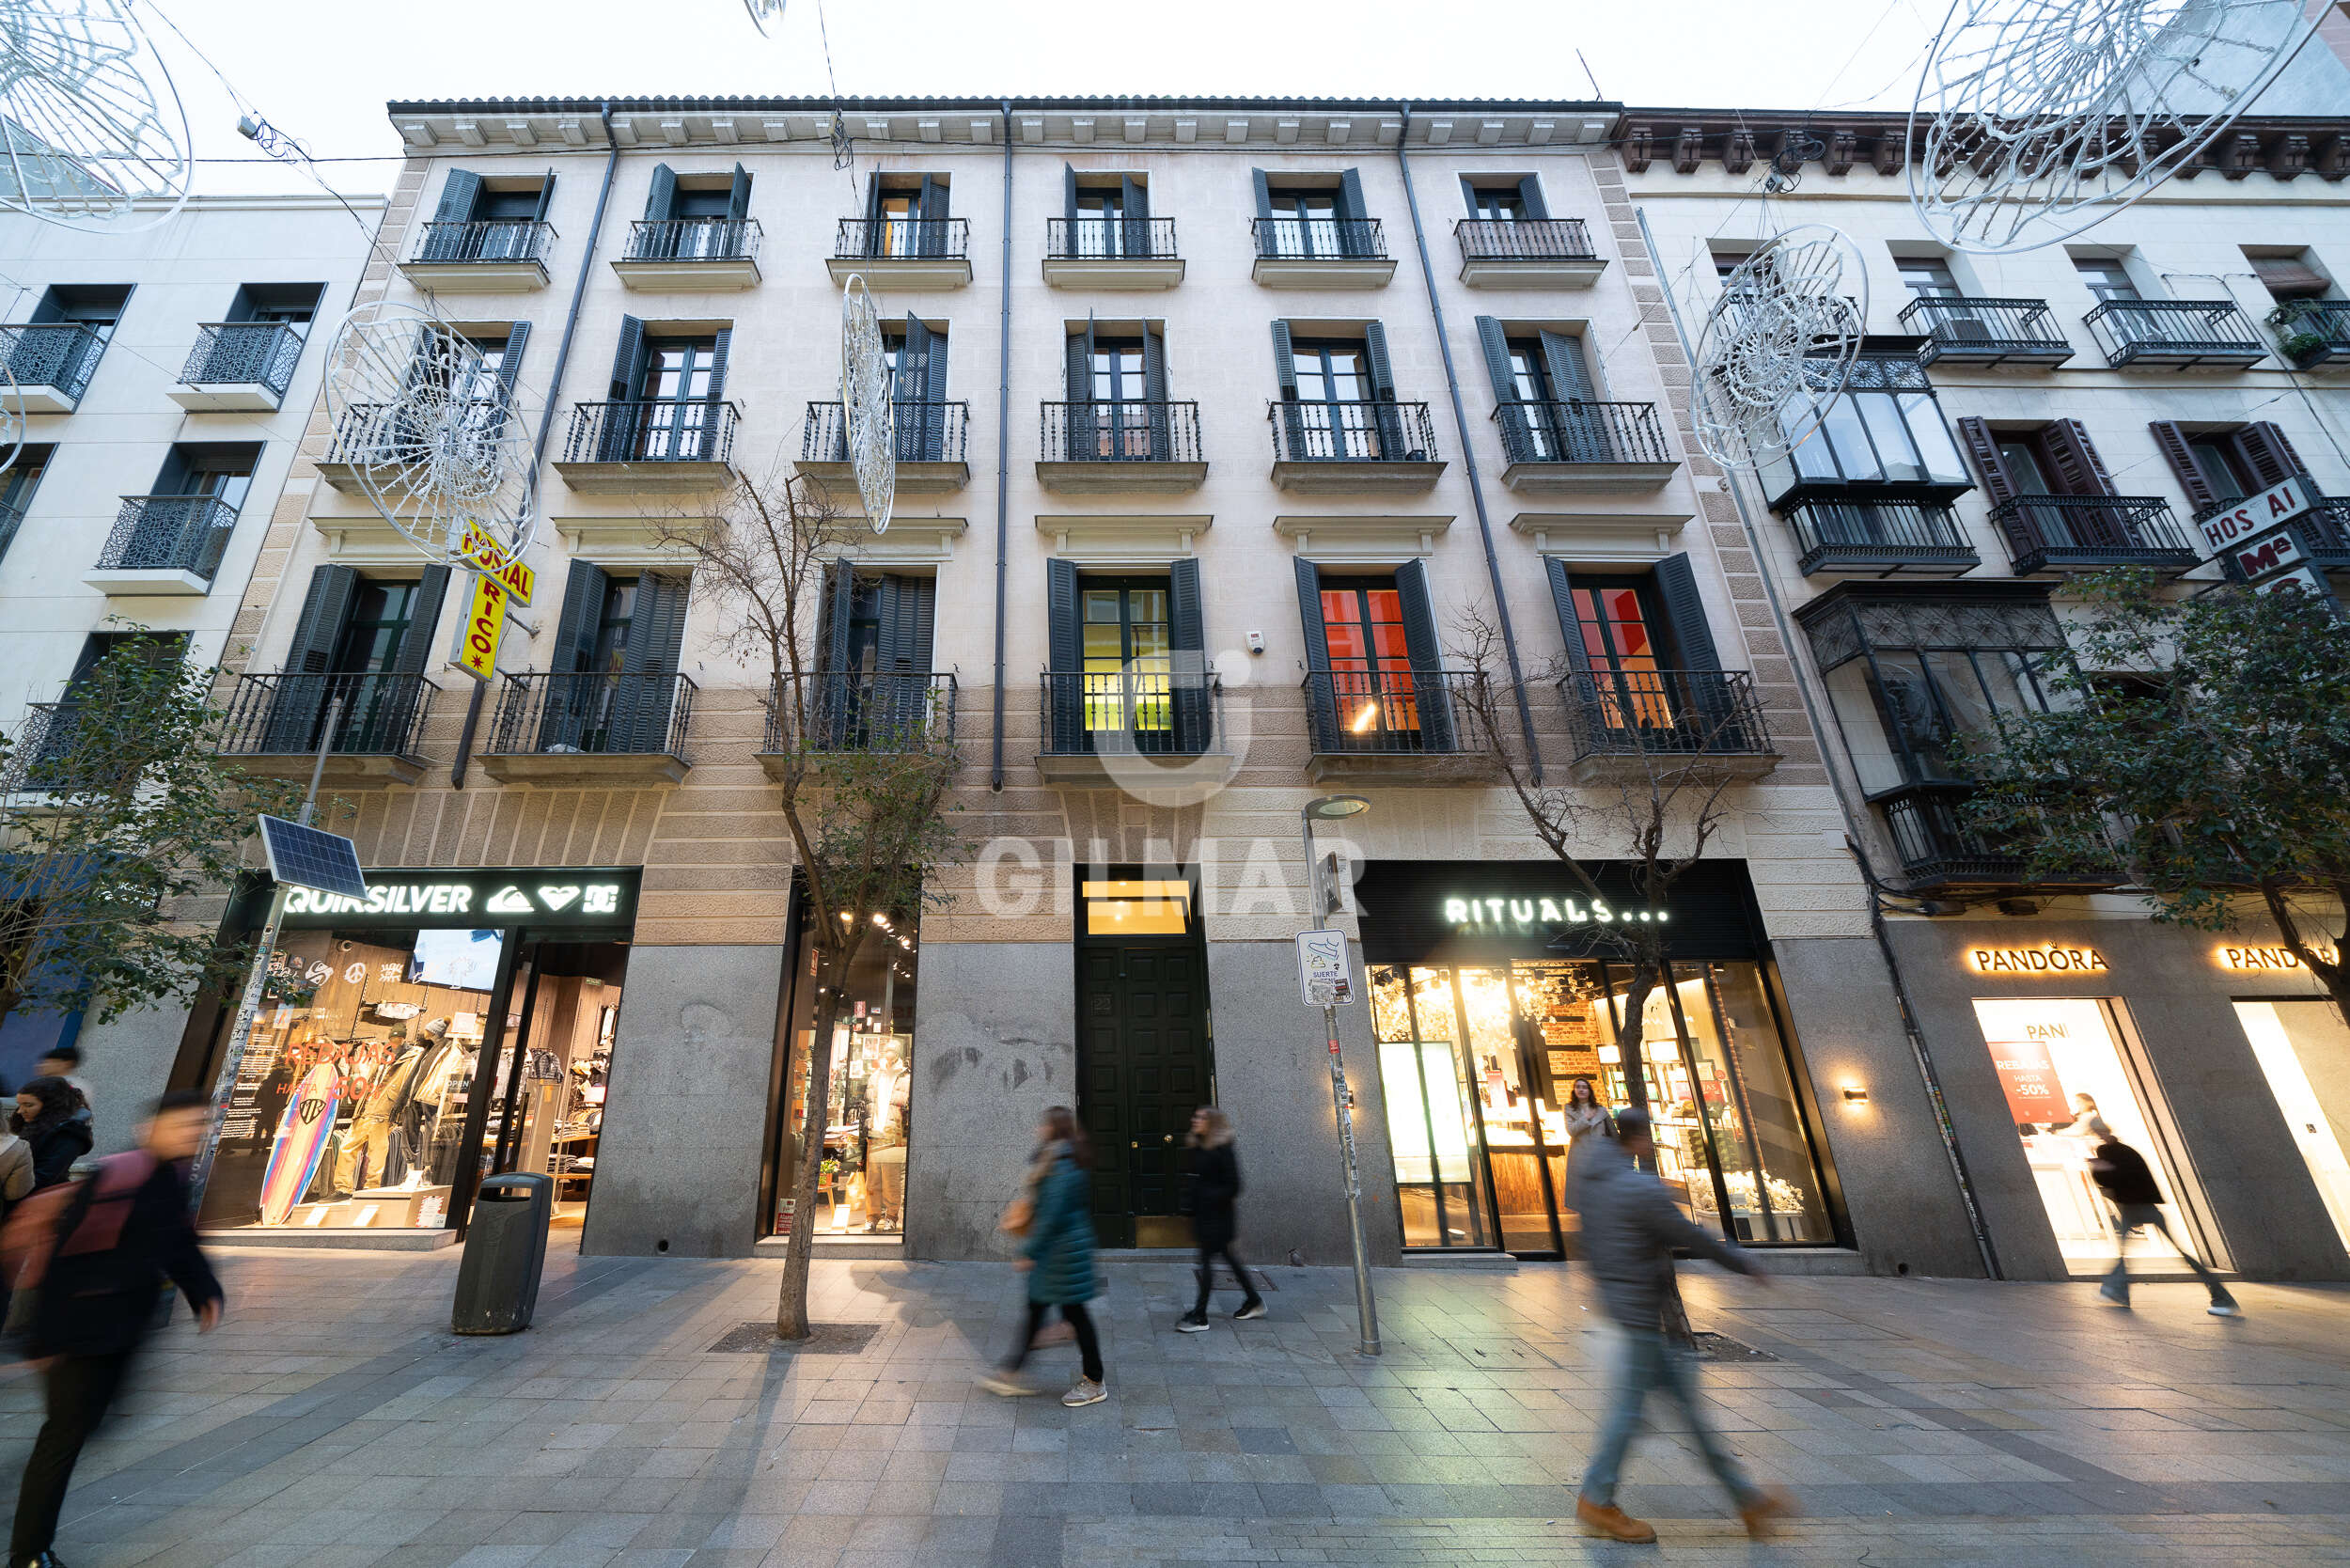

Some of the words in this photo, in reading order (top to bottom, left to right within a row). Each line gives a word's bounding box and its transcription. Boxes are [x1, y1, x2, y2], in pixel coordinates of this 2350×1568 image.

[471, 580, 501, 654] RICO
[284, 886, 473, 914] QUIKSILVER
[1976, 949, 2110, 971] PANDORA
[285, 1042, 397, 1065] REBAJAS
[275, 1082, 318, 1095] HASTA
[446, 1079, 470, 1089] OPEN
[2016, 1084, 2049, 1096] -50%
